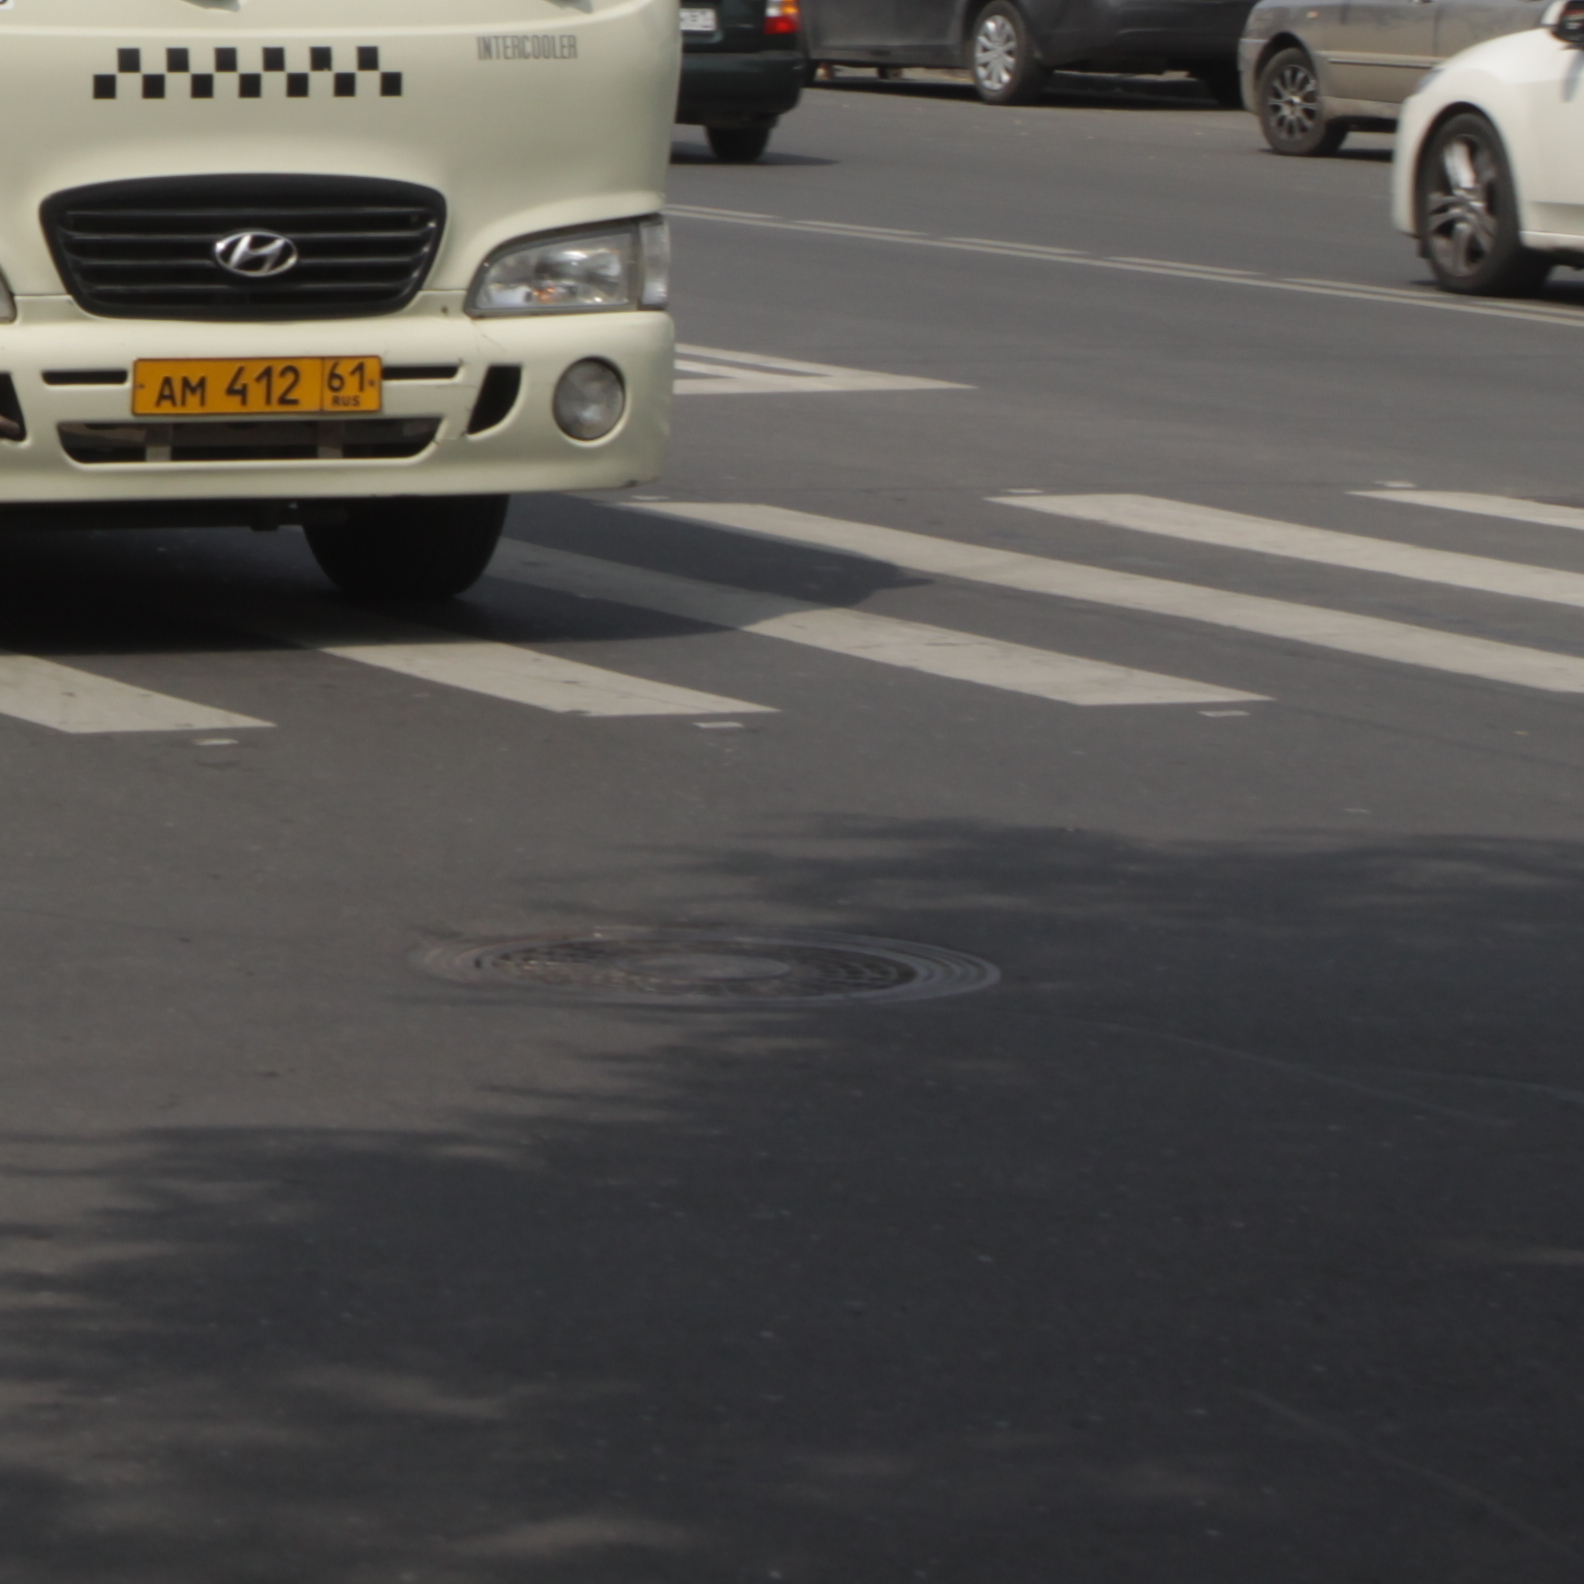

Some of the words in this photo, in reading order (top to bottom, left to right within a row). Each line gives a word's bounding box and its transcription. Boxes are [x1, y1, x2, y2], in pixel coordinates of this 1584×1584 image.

[476, 34, 579, 61] INTERCOOLER
[155, 375, 208, 408] АМ
[225, 365, 301, 407] 412
[326, 361, 366, 393] 61
[332, 395, 362, 407] RUS
